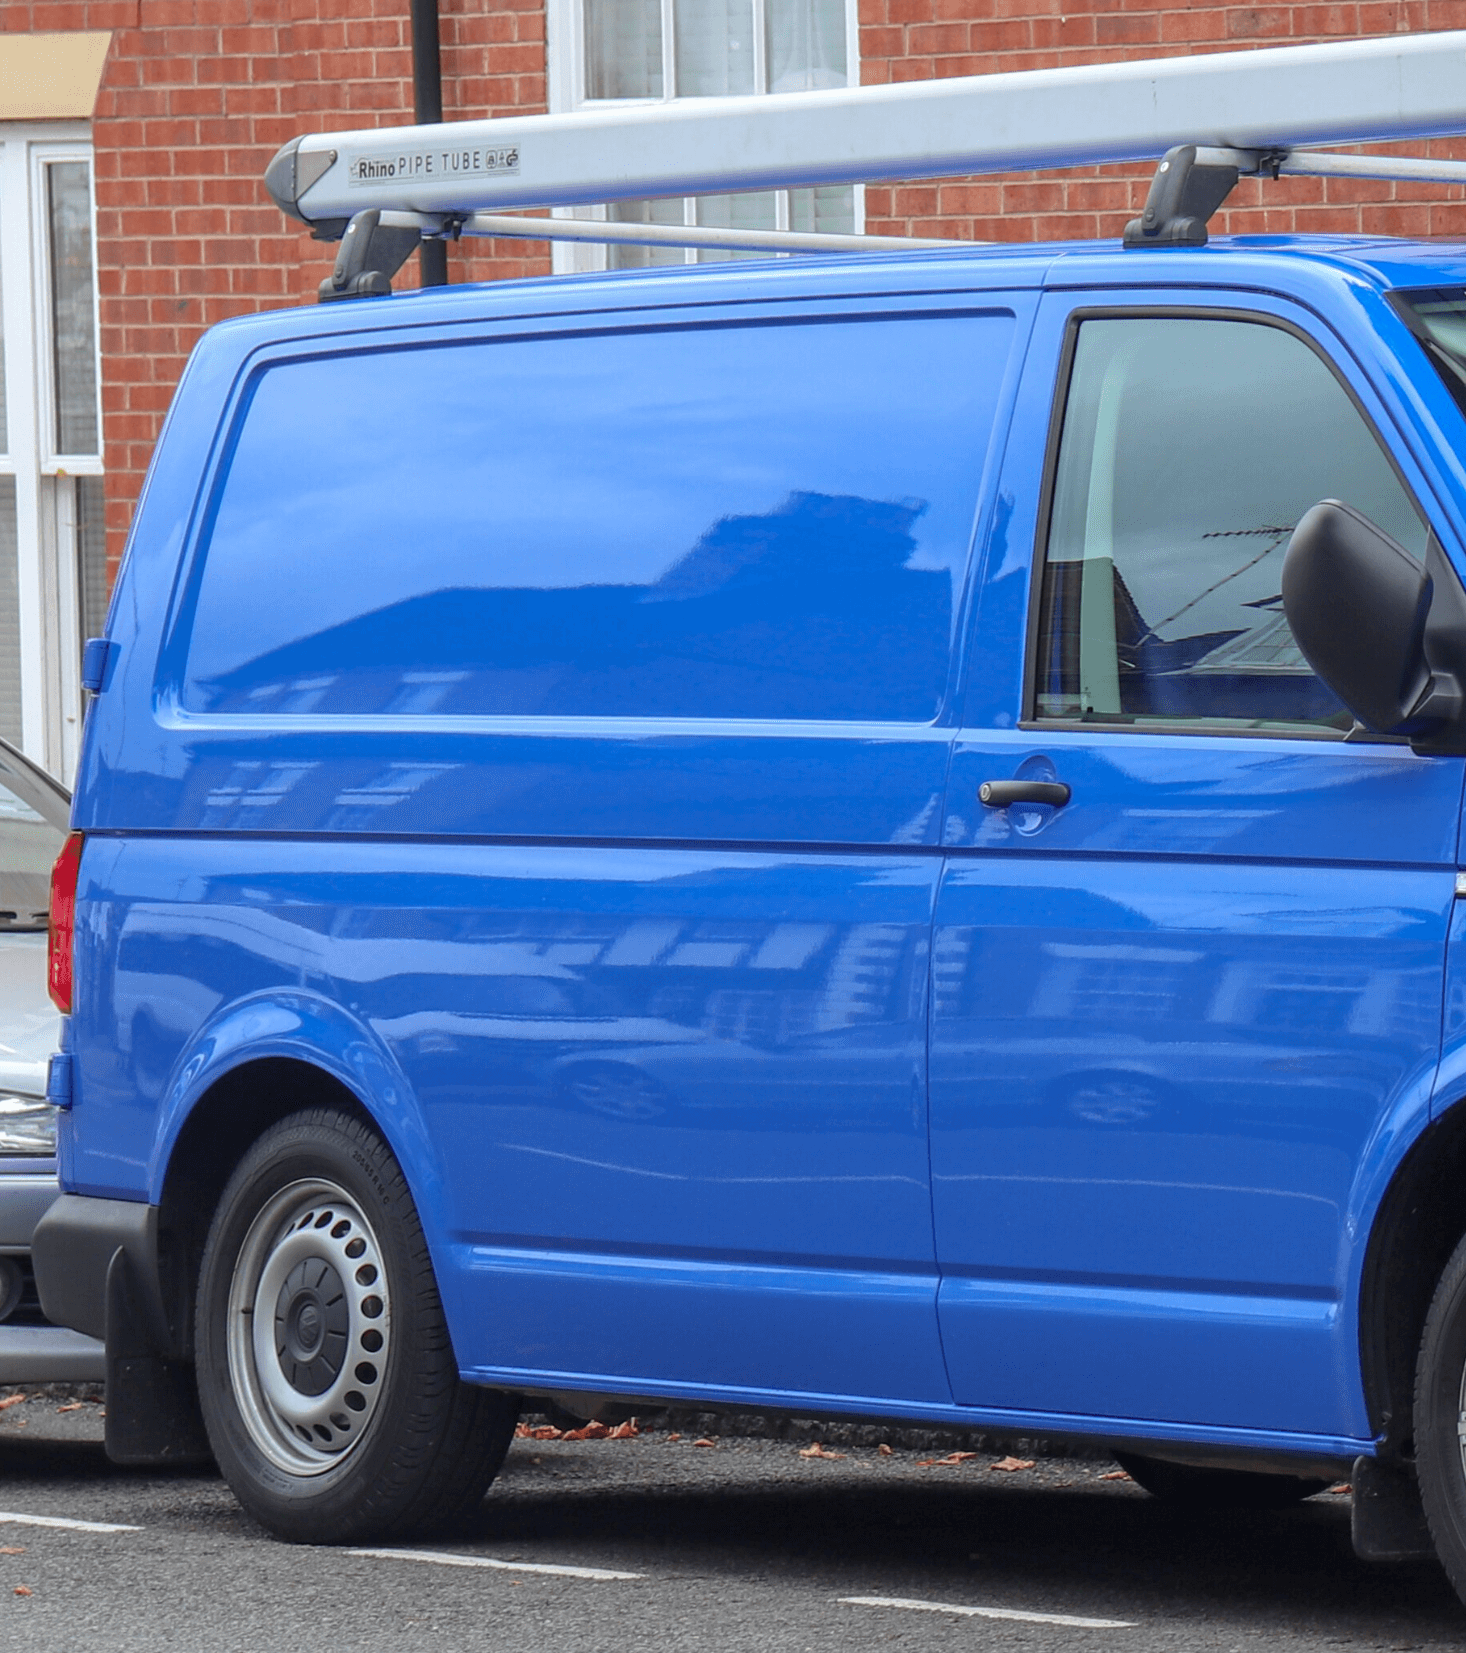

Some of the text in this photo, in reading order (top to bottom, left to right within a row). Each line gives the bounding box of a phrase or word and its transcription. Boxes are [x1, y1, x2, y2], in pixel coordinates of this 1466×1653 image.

[359, 161, 395, 179] Rhino
[399, 154, 433, 175] PIPE
[442, 151, 480, 171] TUBE
